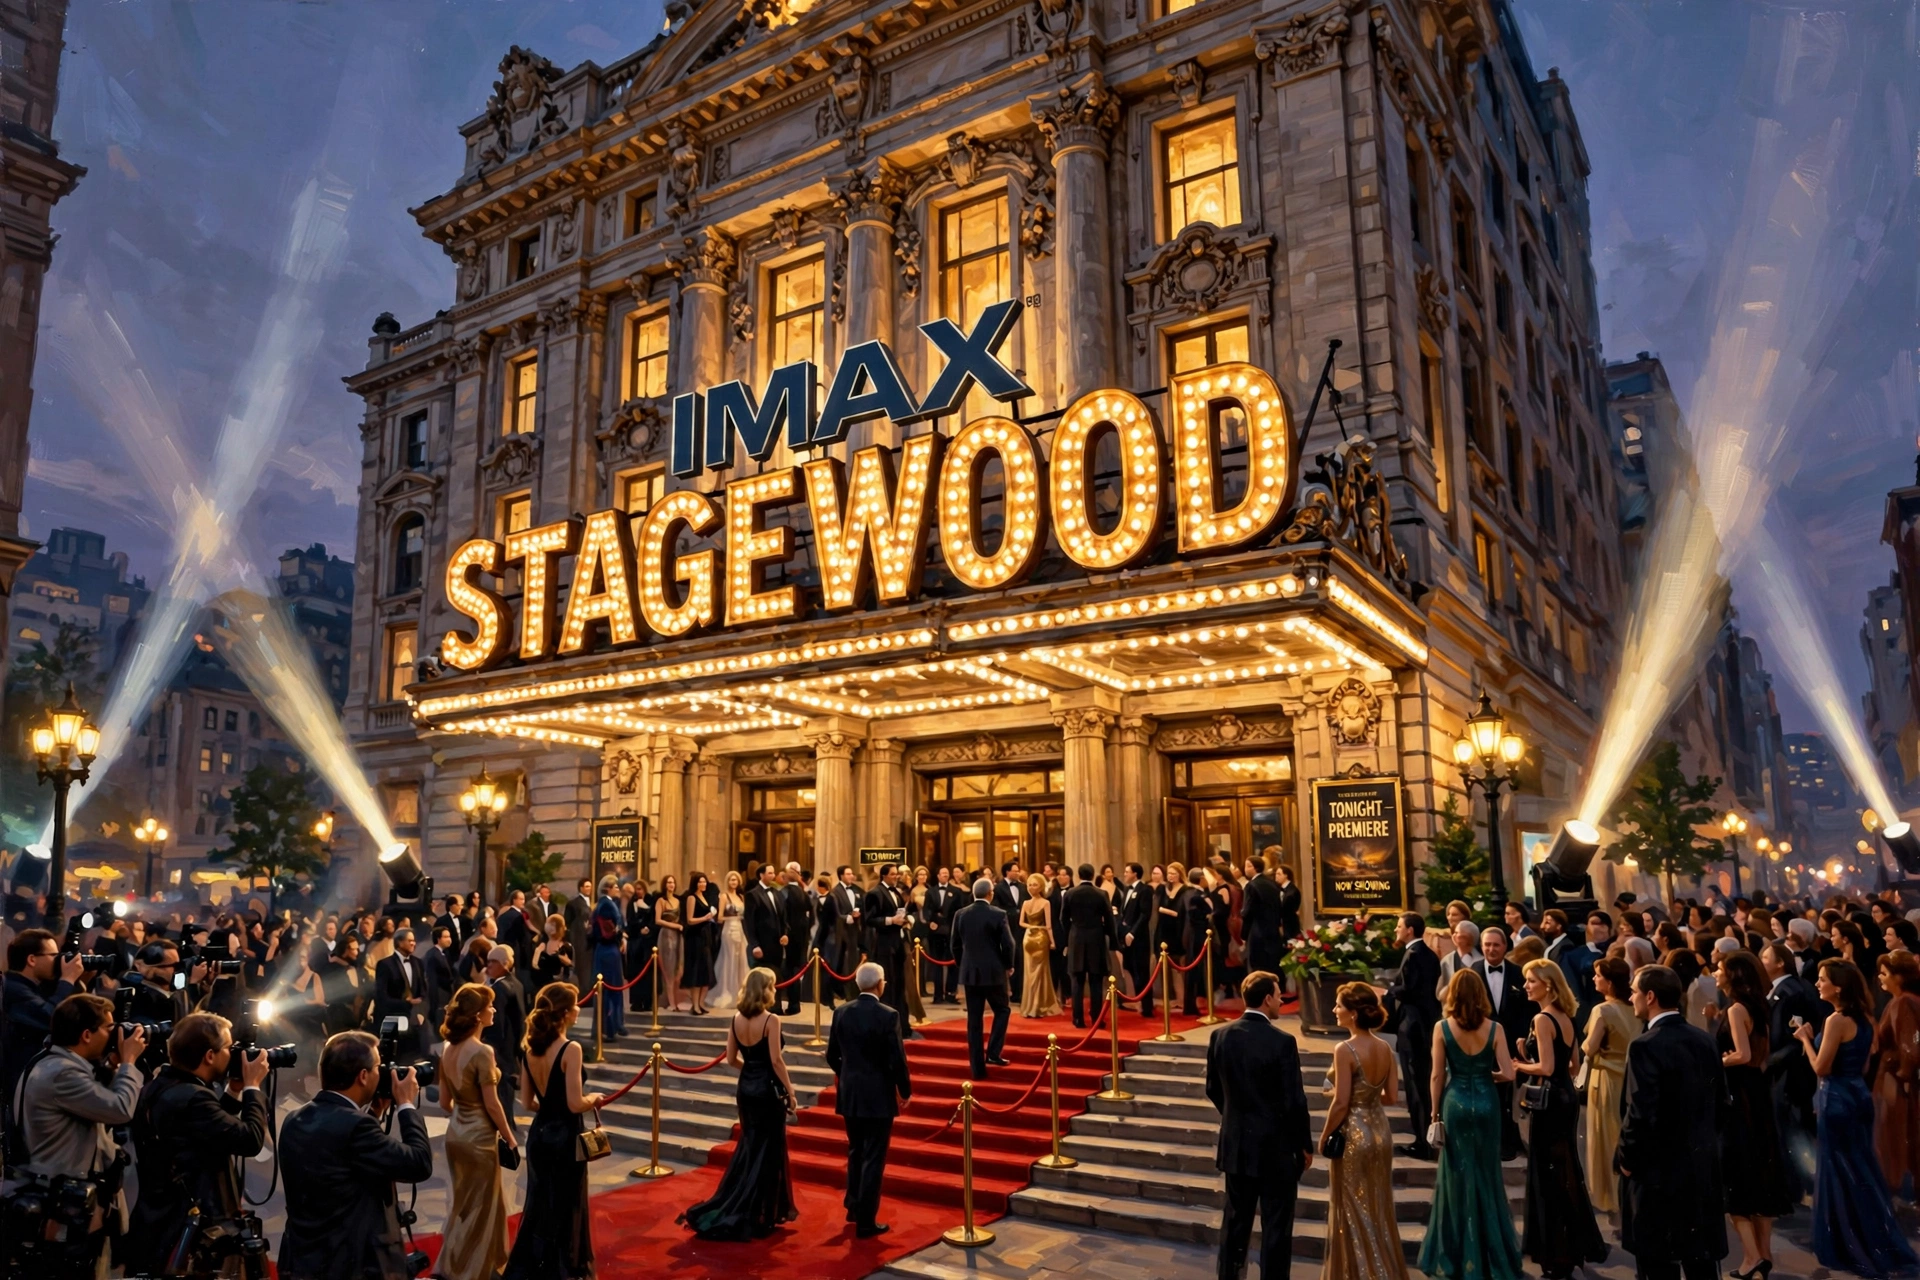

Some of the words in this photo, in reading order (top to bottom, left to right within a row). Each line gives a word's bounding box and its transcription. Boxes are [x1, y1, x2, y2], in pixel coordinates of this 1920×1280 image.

[672, 298, 1031, 477] IMAX
[441, 361, 1297, 671] STAGEWOOD
[1329, 800, 1383, 818] TONIGHT
[1328, 820, 1389, 839] PREMIERE
[601, 835, 633, 848] TONIGHT
[1335, 880, 1353, 891] NOW
